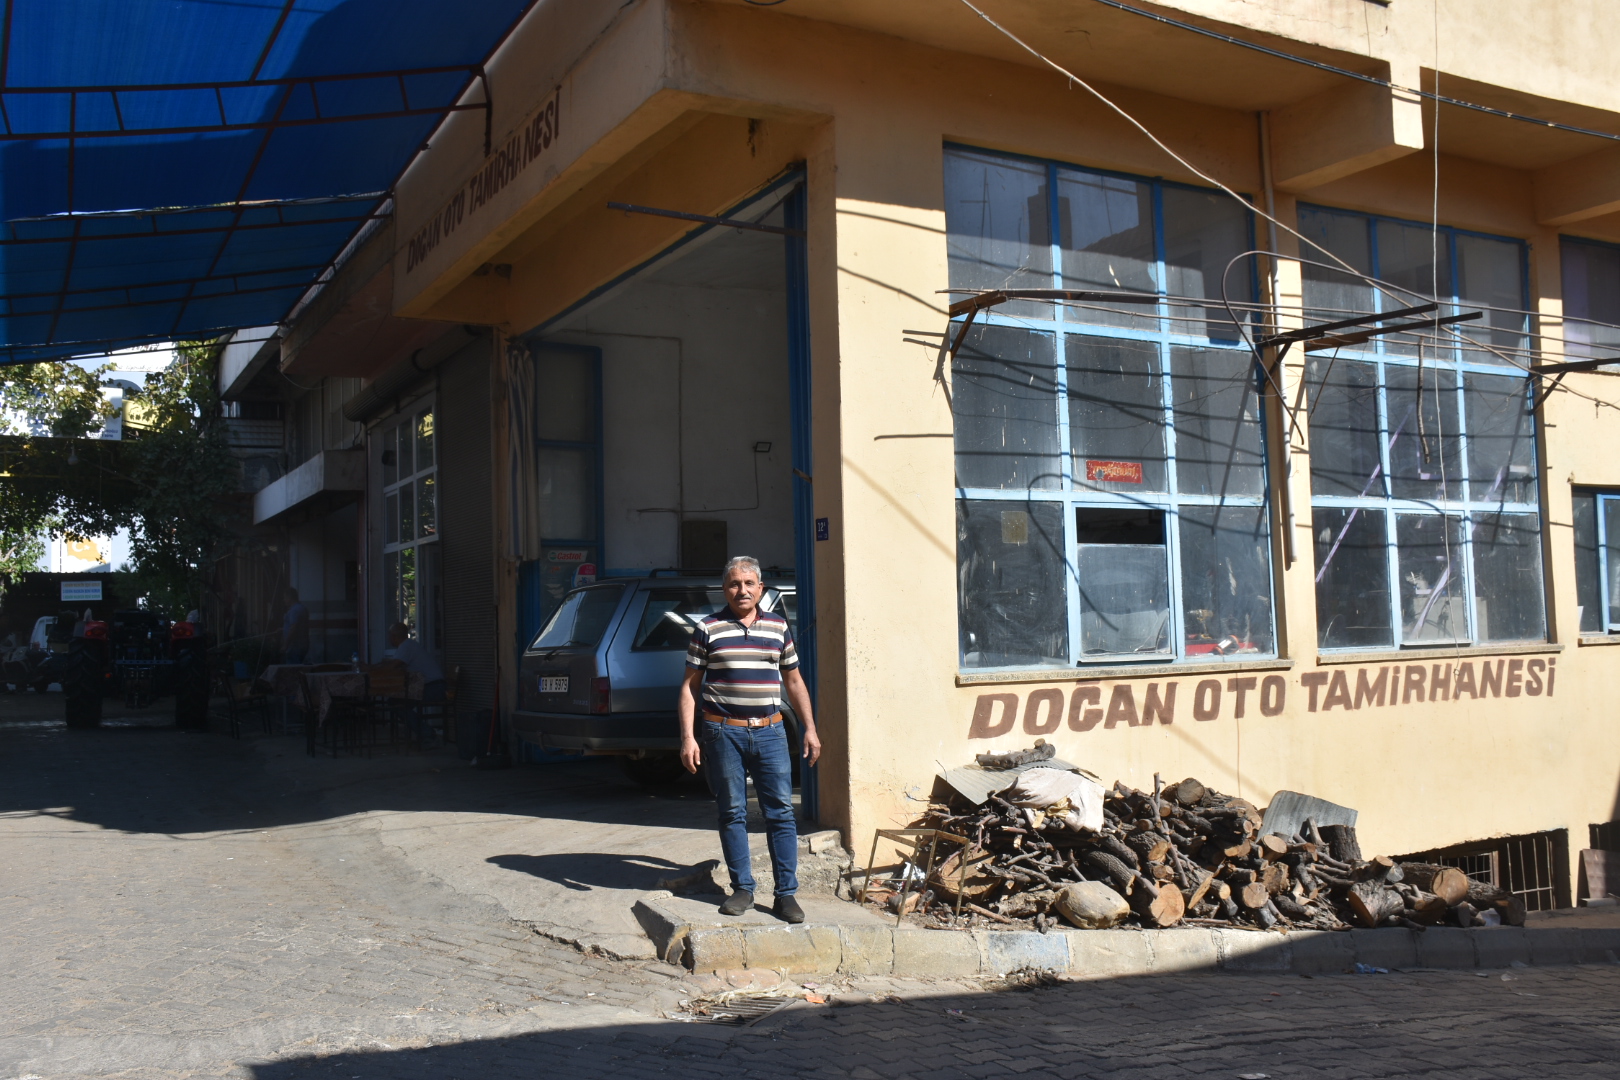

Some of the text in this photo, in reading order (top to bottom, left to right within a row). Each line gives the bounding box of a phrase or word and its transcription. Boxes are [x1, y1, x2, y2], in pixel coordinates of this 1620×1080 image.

[444, 189, 466, 238] OTO
[557, 552, 582, 560] Castrol
[555, 678, 567, 690] 5979
[968, 678, 1179, 739] DOĞAN
[1193, 675, 1286, 721] OTO
